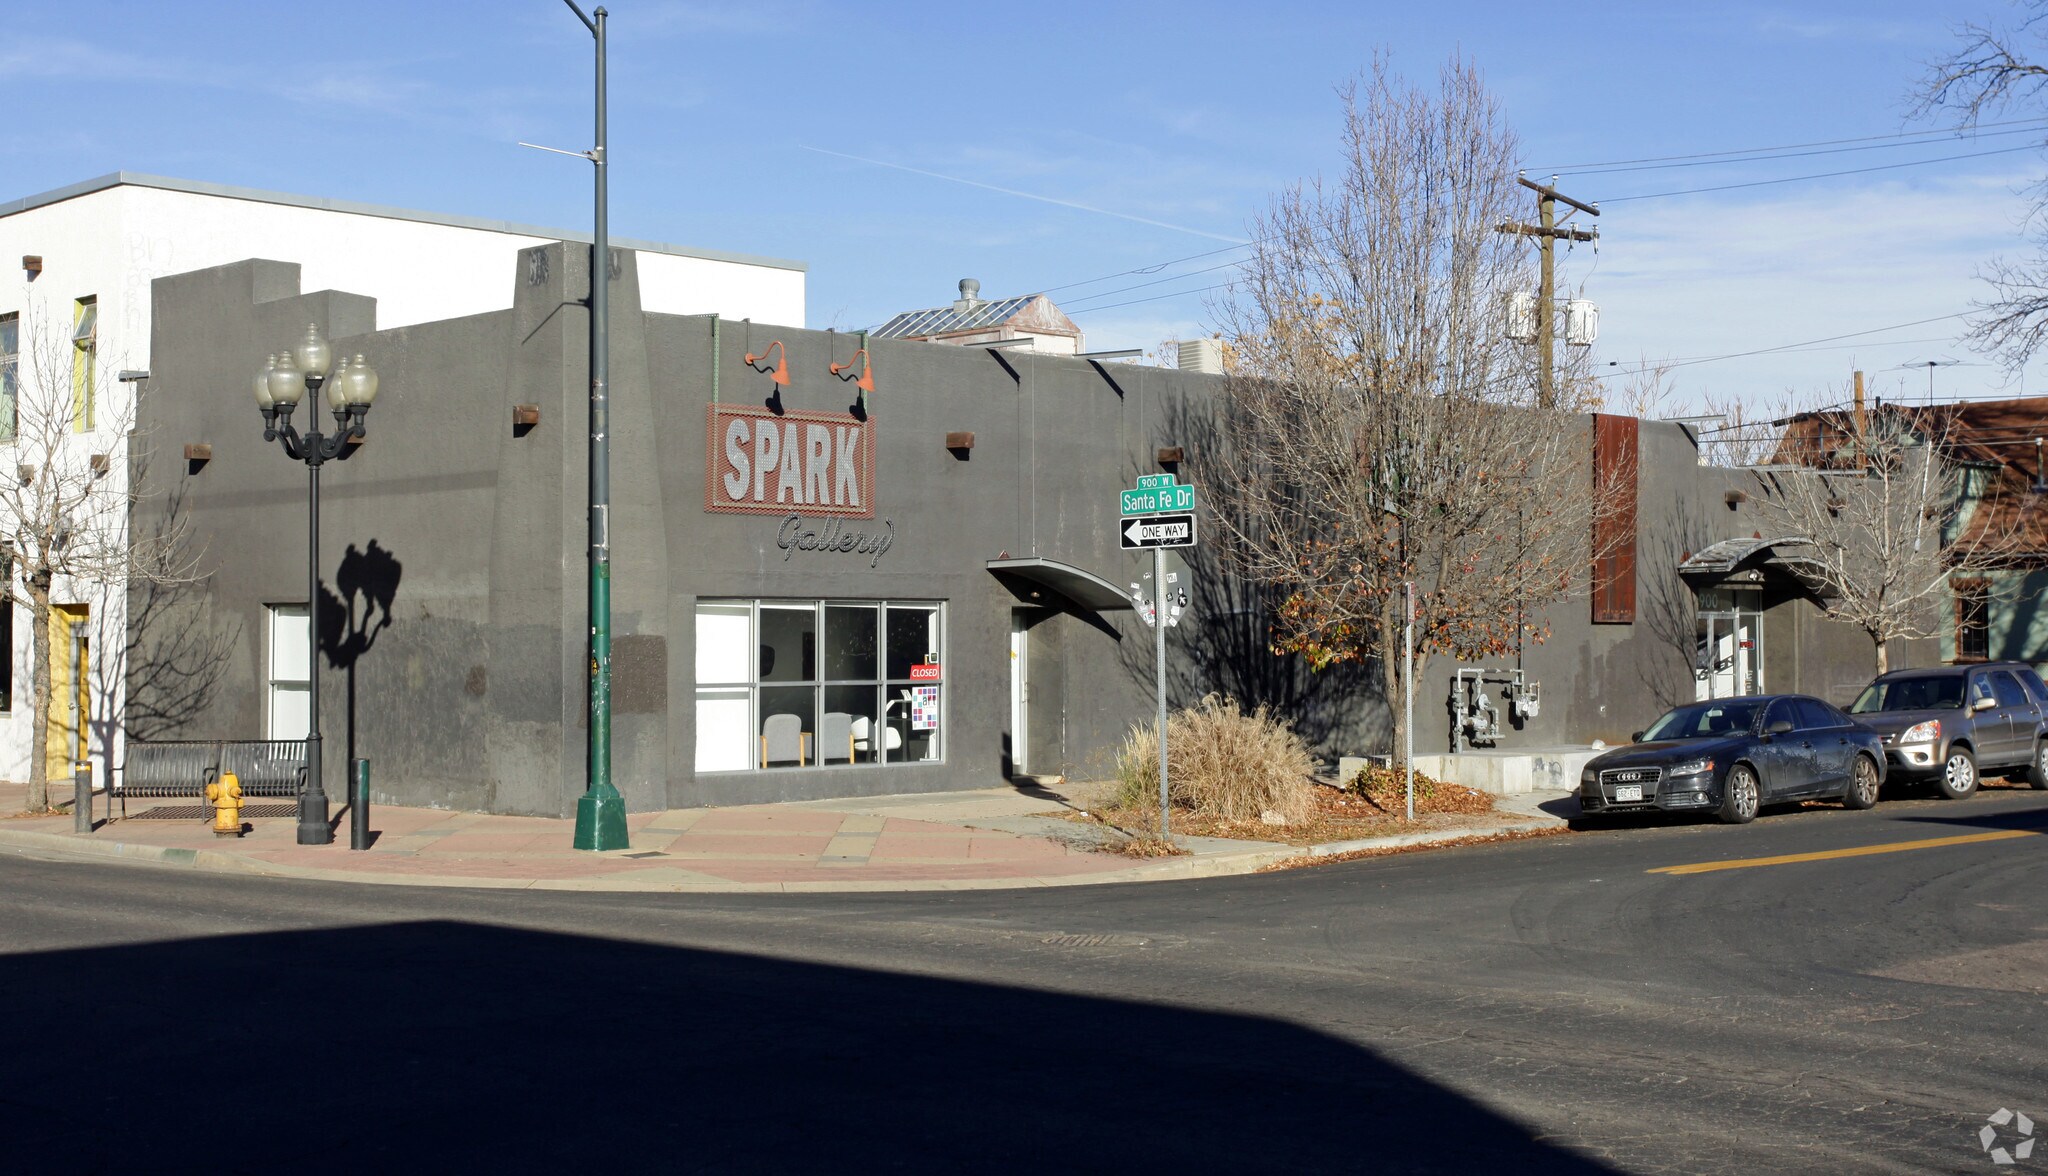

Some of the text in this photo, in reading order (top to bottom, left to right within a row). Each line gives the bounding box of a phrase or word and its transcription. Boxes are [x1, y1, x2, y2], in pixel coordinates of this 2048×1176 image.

[723, 419, 860, 507] SPARK
[1142, 476, 1169, 487] 900 W
[1124, 489, 1191, 511] Santa Fe Dr
[1142, 524, 1185, 539] ONE WAY
[776, 512, 895, 568] Gallery
[1699, 593, 1718, 609] 900
[911, 668, 938, 677] CLOSED
